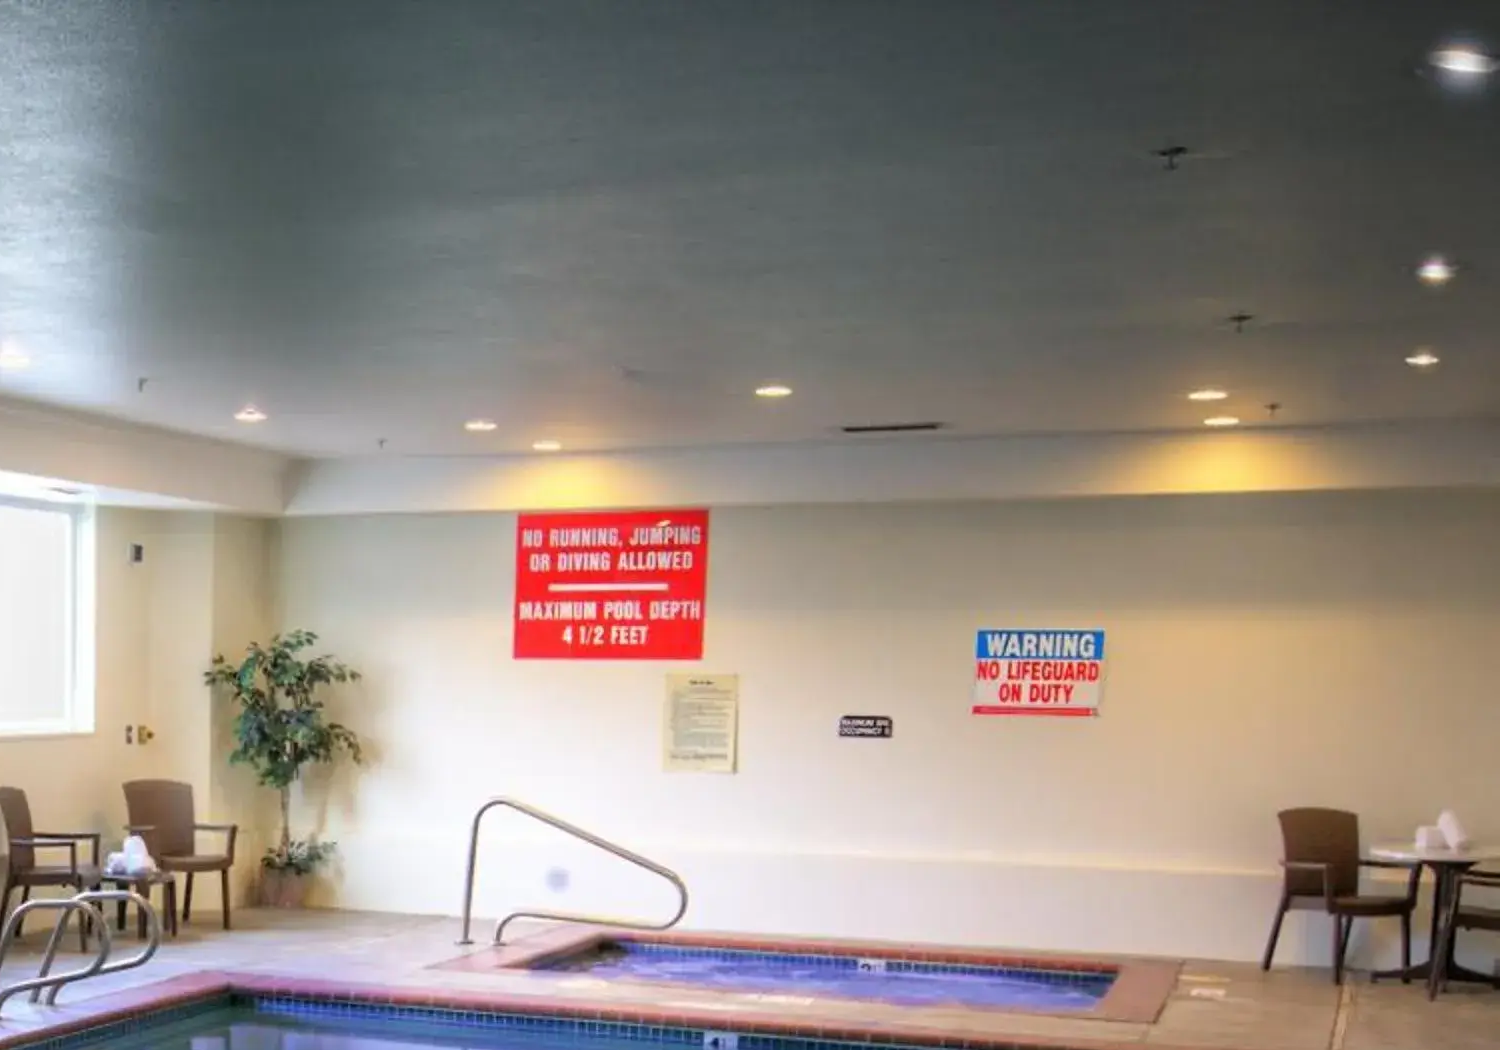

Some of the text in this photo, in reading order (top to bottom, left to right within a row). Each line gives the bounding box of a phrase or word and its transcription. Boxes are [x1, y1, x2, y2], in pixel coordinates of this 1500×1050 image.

[522, 525, 701, 548] NO RUNNING, JUMPING
[529, 551, 693, 572] OR DIVING ALLOWED
[519, 600, 701, 620] MAXIMUM POOL DEPTH
[562, 625, 649, 645] 4 1/2 FEET
[987, 633, 1096, 658] WARNING
[976, 661, 1100, 681] NO LIFEGUARD
[999, 683, 1074, 703] ON DUTY
